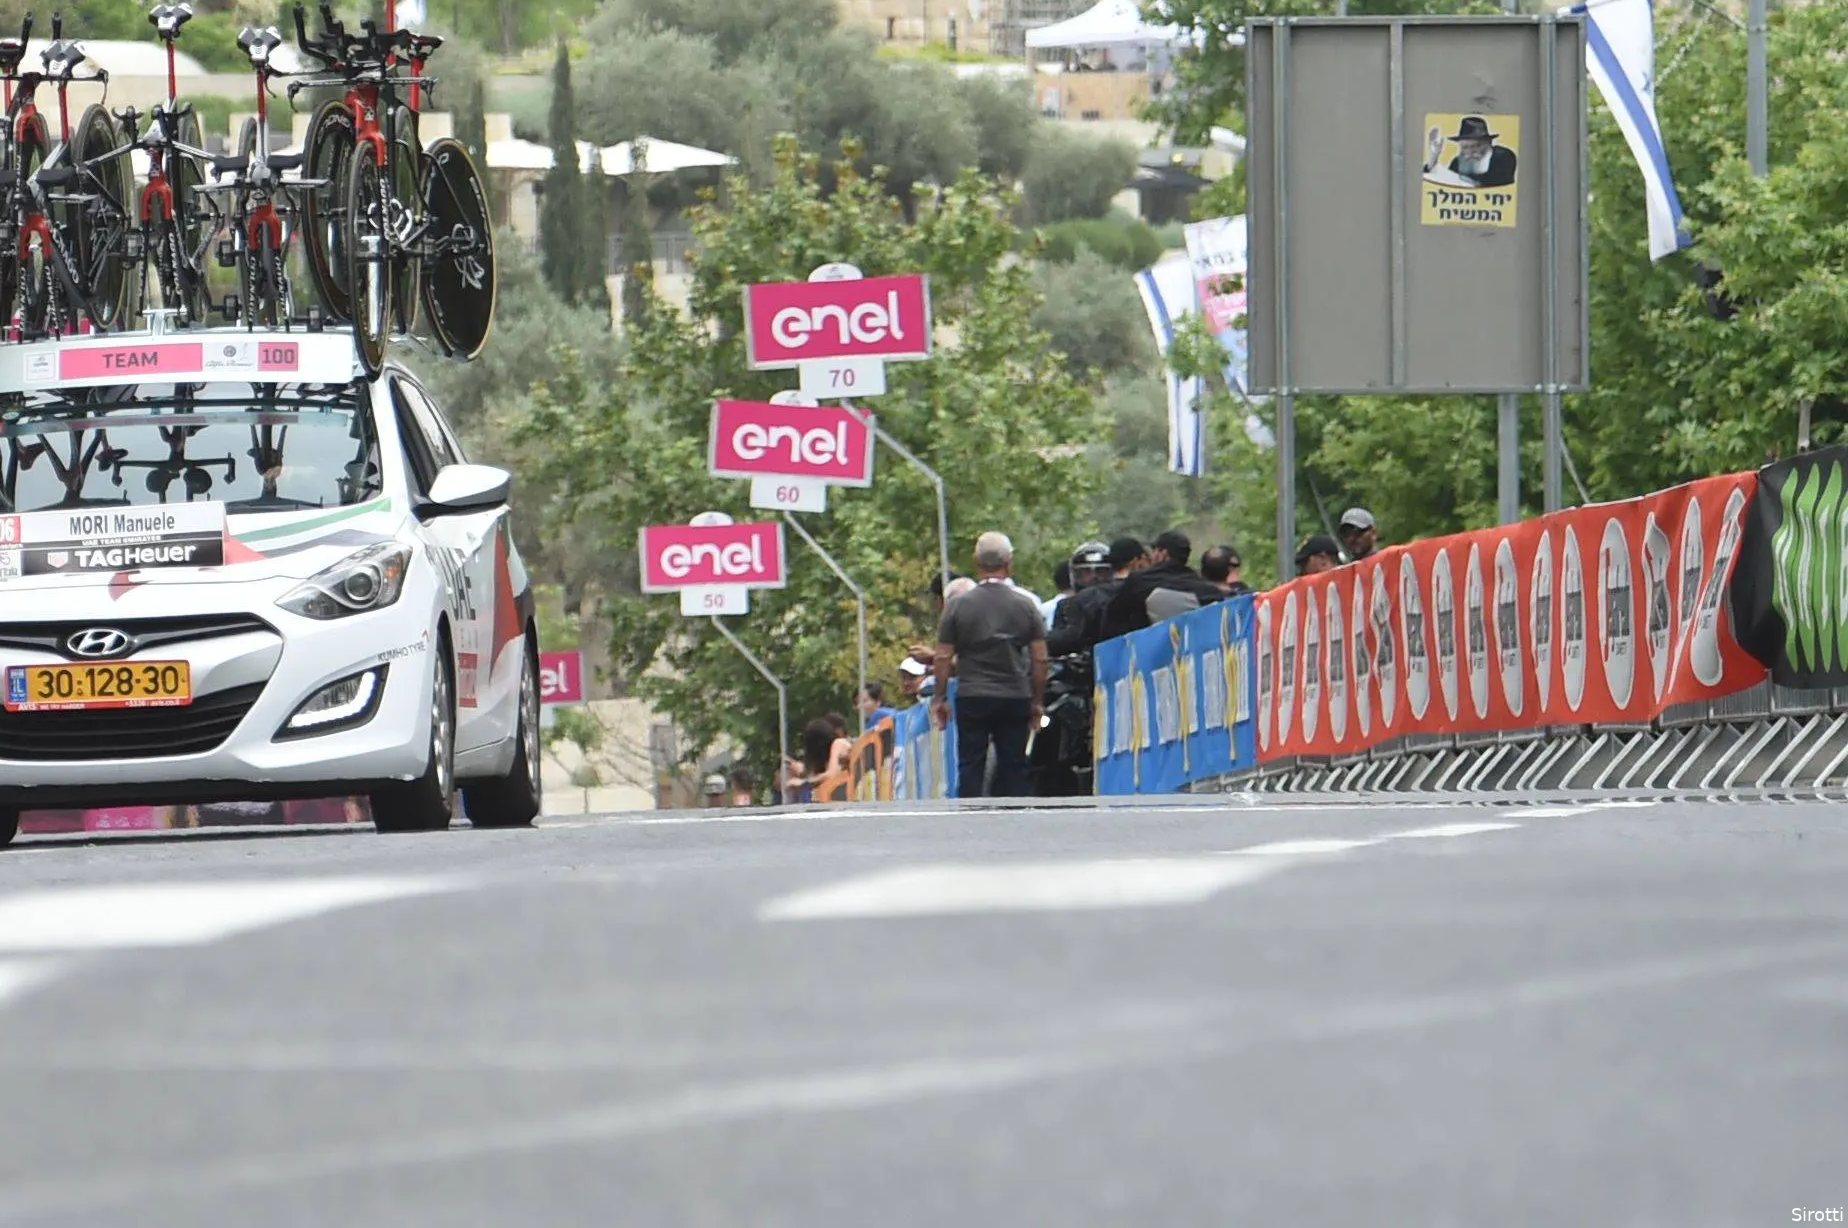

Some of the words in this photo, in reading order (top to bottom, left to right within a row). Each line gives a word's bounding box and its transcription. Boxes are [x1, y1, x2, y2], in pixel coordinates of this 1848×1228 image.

[1427, 189, 1477, 208] המלך
[1485, 193, 1512, 206] יחי
[1439, 208, 1503, 222] המשיח
[771, 290, 905, 348] enel
[102, 352, 159, 369] TEAM
[262, 348, 296, 364] 100
[829, 368, 855, 387] 70
[732, 420, 849, 466] enel
[776, 486, 800, 503] 60
[69, 515, 109, 536] MORI
[113, 512, 176, 532] Manuele
[660, 533, 766, 578] enel
[704, 593, 724, 609] 50
[378, 645, 408, 662] KUMHO
[408, 641, 426, 656] TYRE
[541, 661, 569, 696] el
